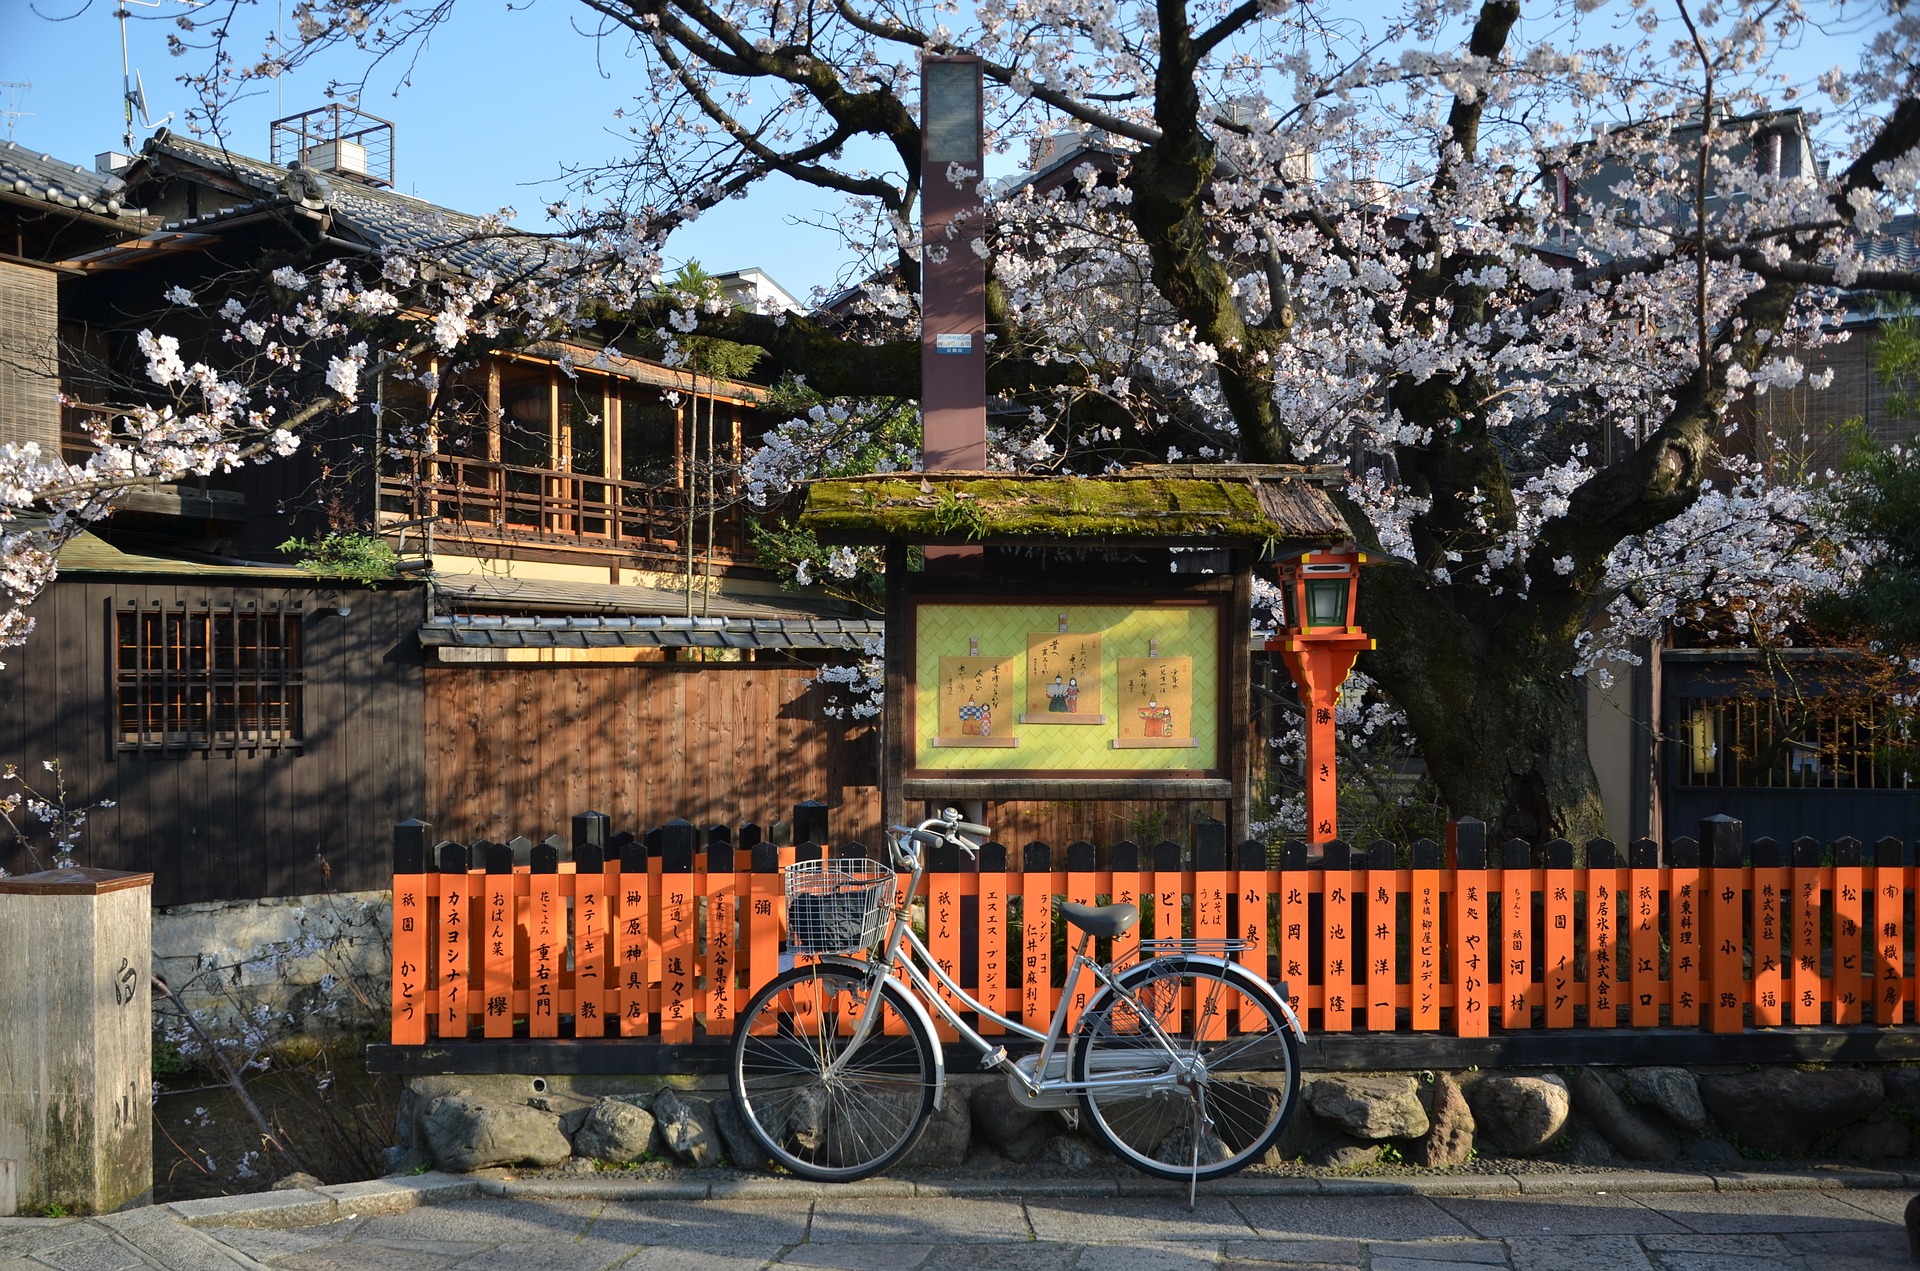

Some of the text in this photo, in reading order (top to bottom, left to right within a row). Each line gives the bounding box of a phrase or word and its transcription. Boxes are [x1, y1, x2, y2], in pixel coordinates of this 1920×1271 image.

[974, 670, 983, 691] 人生の
[1316, 708, 1332, 834] 勝きぬ
[447, 891, 461, 1022] カネヨシナイト
[491, 892, 505, 956] おばん菜
[536, 891, 551, 1017] 花こよみ 重右エ門
[584, 893, 595, 953] ステーキ
[626, 890, 641, 1018] 榊原神具店
[668, 892, 685, 1019] 切通し 進々堂
[714, 892, 728, 1020] 古美術 水谷集光堂
[1039, 894, 1048, 942] ラウンジ
[1200, 888, 1208, 925] うどん
[1212, 889, 1222, 925] 生そば
[1287, 888, 1303, 1013] 北岡敏男
[1329, 887, 1346, 1012] 外池洋隆
[1421, 888, 1432, 1014] 日本橋 柳屋ビルディング
[1465, 886, 1481, 1014] 菜処 やすかわ
[1679, 885, 1693, 1008] 廣東料理 平安
[1720, 886, 1737, 1008] 中小路
[1760, 884, 1776, 1008] 株式会社 大福
[1801, 882, 1816, 1007] ステーキハウス 新吾
[1841, 884, 1856, 1006] 松湯ビル
[1882, 923, 1898, 1004] 雅織工房
[401, 960, 416, 1020] かとう
[1026, 924, 1038, 1018] 仁井田麻利子
[1510, 959, 1526, 1012] 河村
[1554, 955, 1568, 1010] イング
[1638, 957, 1653, 1007] 江口
